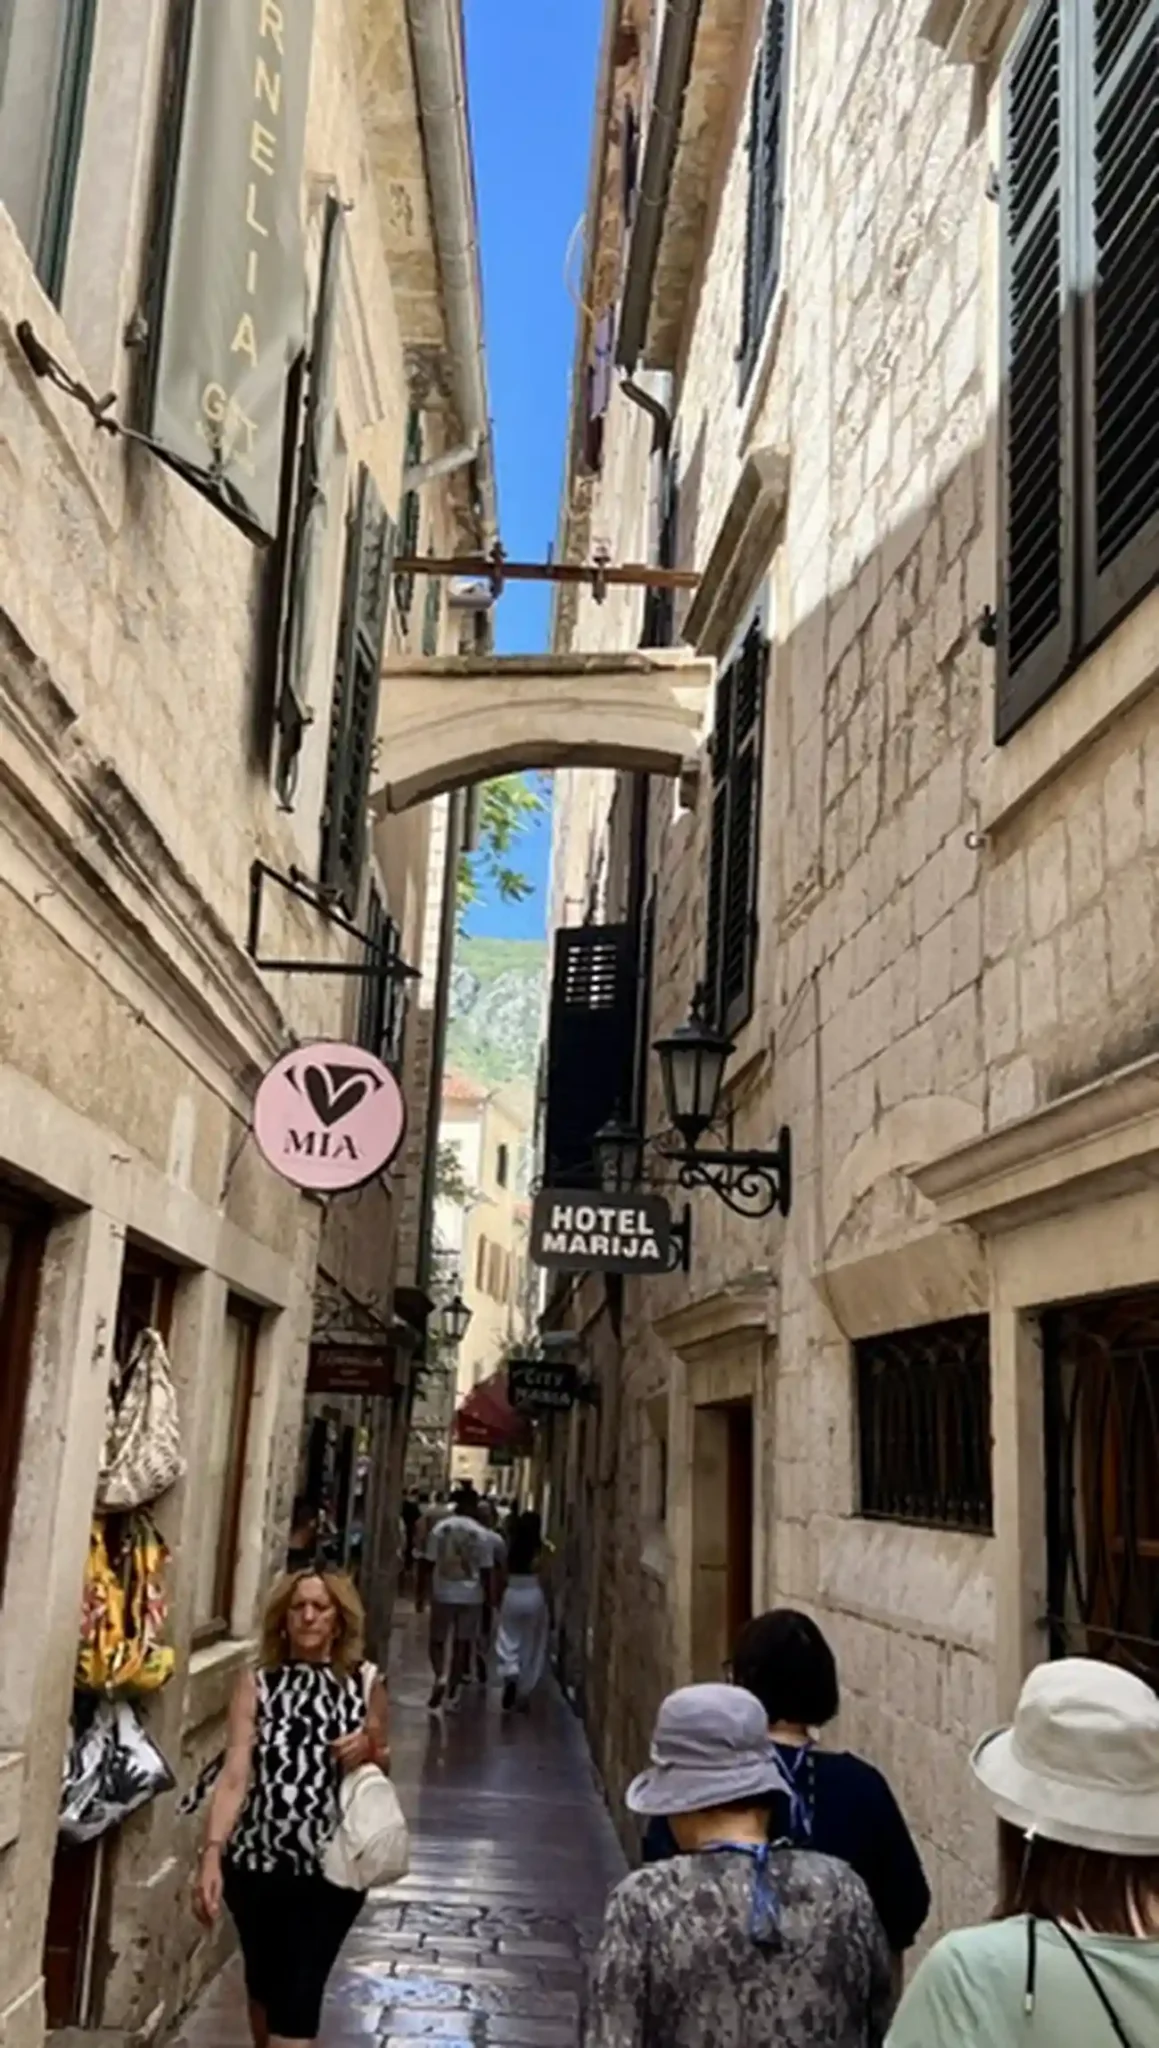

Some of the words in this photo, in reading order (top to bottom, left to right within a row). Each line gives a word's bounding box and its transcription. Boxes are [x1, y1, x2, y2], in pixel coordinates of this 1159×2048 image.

[283, 1128, 359, 1160] MIA
[551, 1204, 655, 1236] HOTEL
[541, 1231, 661, 1260] MARIJA
